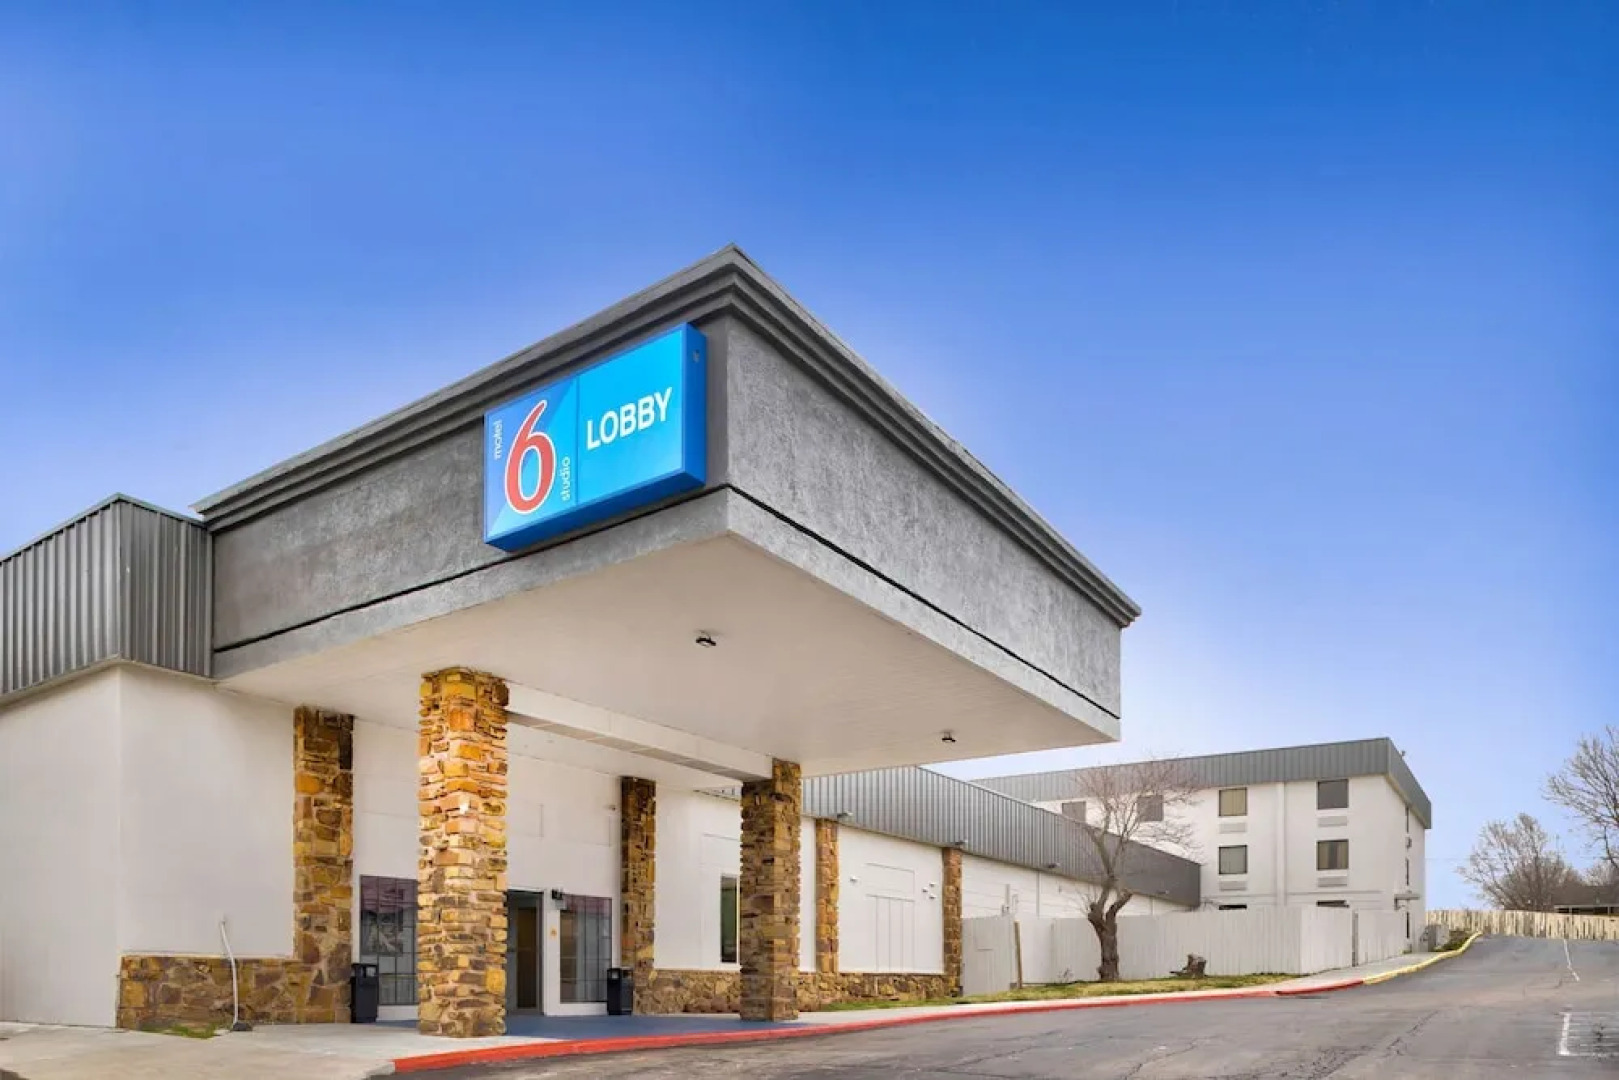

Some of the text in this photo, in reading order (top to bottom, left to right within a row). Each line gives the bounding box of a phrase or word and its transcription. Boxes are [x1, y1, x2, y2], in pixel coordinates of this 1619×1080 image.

[493, 419, 502, 460] motel
[586, 387, 672, 450] LOBBY
[505, 399, 557, 515] 6
[560, 456, 571, 501] studio
